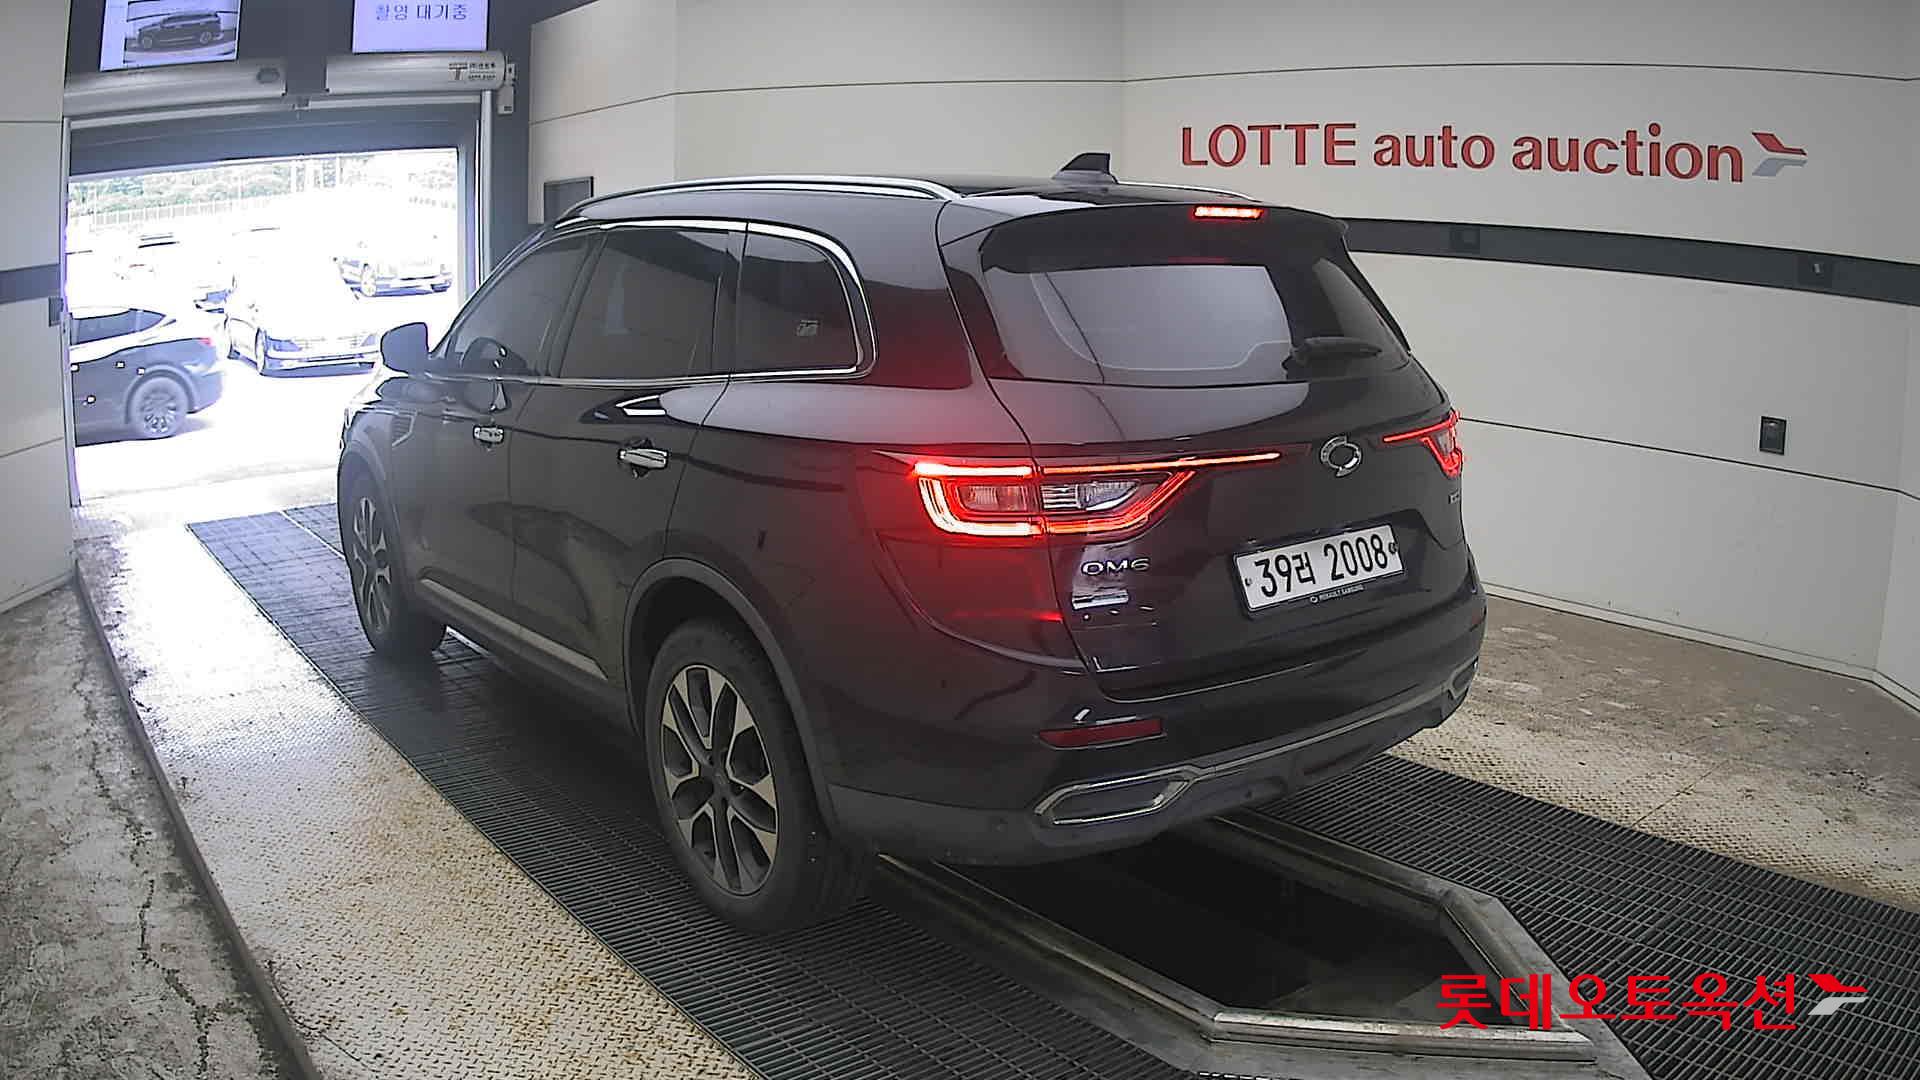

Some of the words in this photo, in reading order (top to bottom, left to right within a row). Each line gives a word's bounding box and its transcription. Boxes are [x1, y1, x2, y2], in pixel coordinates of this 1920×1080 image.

[416, 4, 467, 20] 대기중
[1182, 123, 1357, 168] LOTTE
[1373, 124, 1496, 169] auto
[1512, 122, 1743, 183] auction
[1323, 533, 1389, 581] 2008
